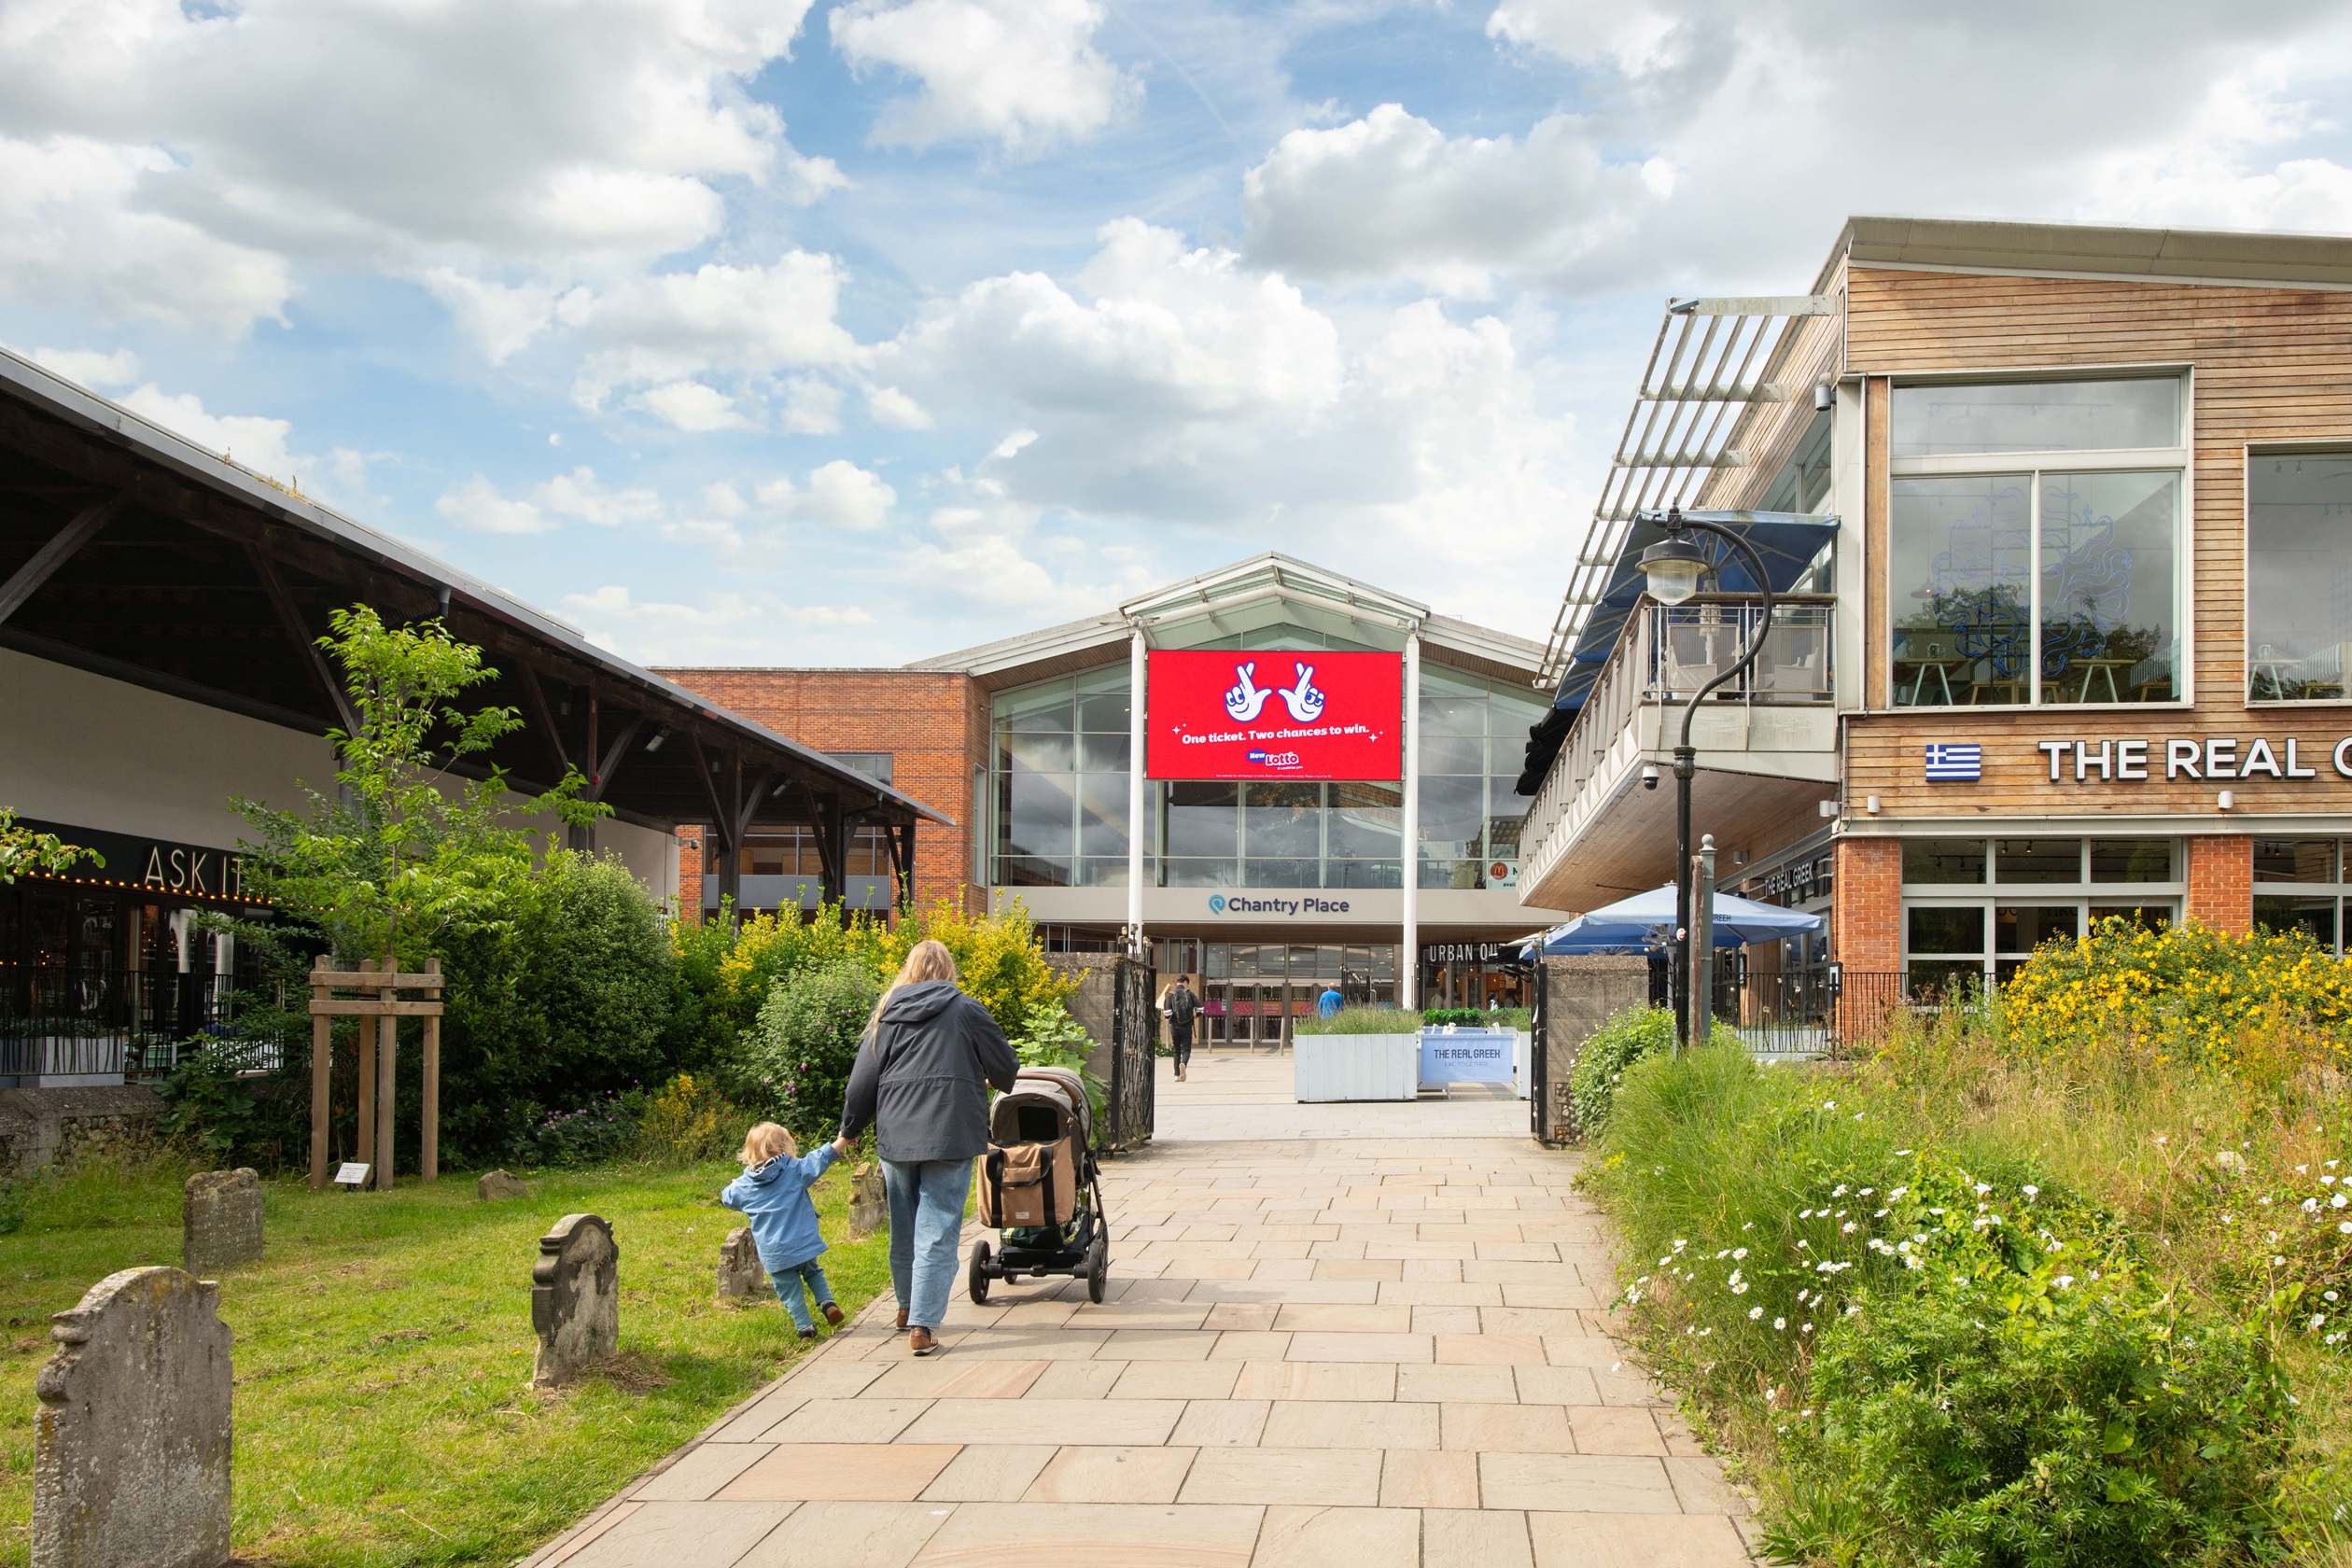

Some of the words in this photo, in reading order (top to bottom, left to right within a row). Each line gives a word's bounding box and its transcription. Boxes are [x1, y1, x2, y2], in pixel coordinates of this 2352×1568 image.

[1182, 734, 1206, 745] One
[1208, 731, 1246, 742] ticket.
[1247, 730, 1275, 740] Two
[1276, 727, 1327, 738] chances
[1329, 726, 1342, 735] to
[1344, 724, 1369, 734] win.
[1266, 752, 1298, 765] Lotto
[2038, 738, 2149, 781] THE
[2166, 736, 2316, 780] REAL
[145, 845, 207, 892] ASK
[1776, 871, 1792, 893] REAL
[1793, 861, 1813, 888] GREEK
[1228, 897, 1299, 916] Chantry
[1304, 898, 1350, 913] Place
[1429, 944, 1474, 962] URBAN
[1434, 1049, 1449, 1058] THE
[1451, 1049, 1473, 1058] REAL
[1474, 1049, 1501, 1059] GREEK
